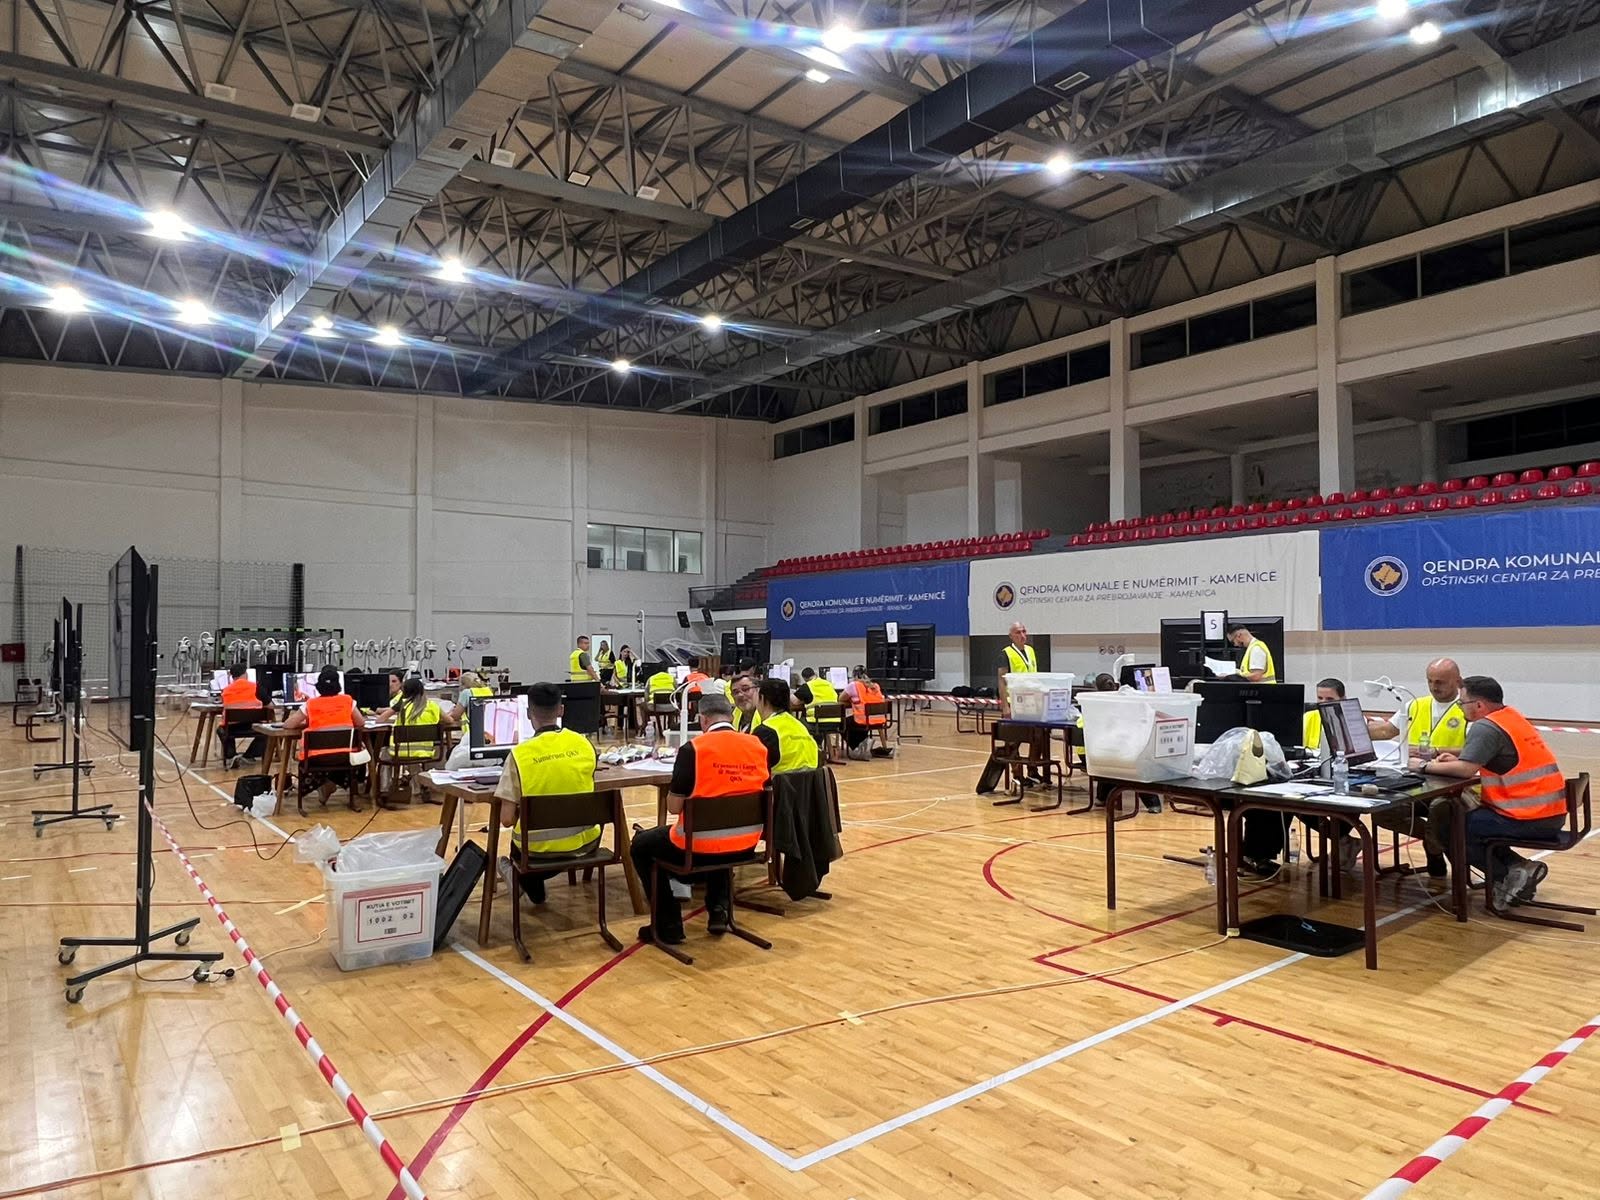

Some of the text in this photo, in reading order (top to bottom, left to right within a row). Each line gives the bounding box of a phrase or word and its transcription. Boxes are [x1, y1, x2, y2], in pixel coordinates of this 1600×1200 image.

[1423, 551, 1600, 575] QENDRA KOMUNAL
[1421, 573, 1489, 587] OPŠTINSKI
[1492, 571, 1547, 583] CENTAR
[1551, 570, 1570, 581] ZA
[1020, 584, 1060, 596] QENDRA
[1062, 580, 1120, 592] KOMUNALE
[1123, 580, 1129, 589] E
[1085, 594, 1094, 602] ZA
[1170, 589, 1216, 598] KAMENICA
[1210, 619, 1217, 630] 5
